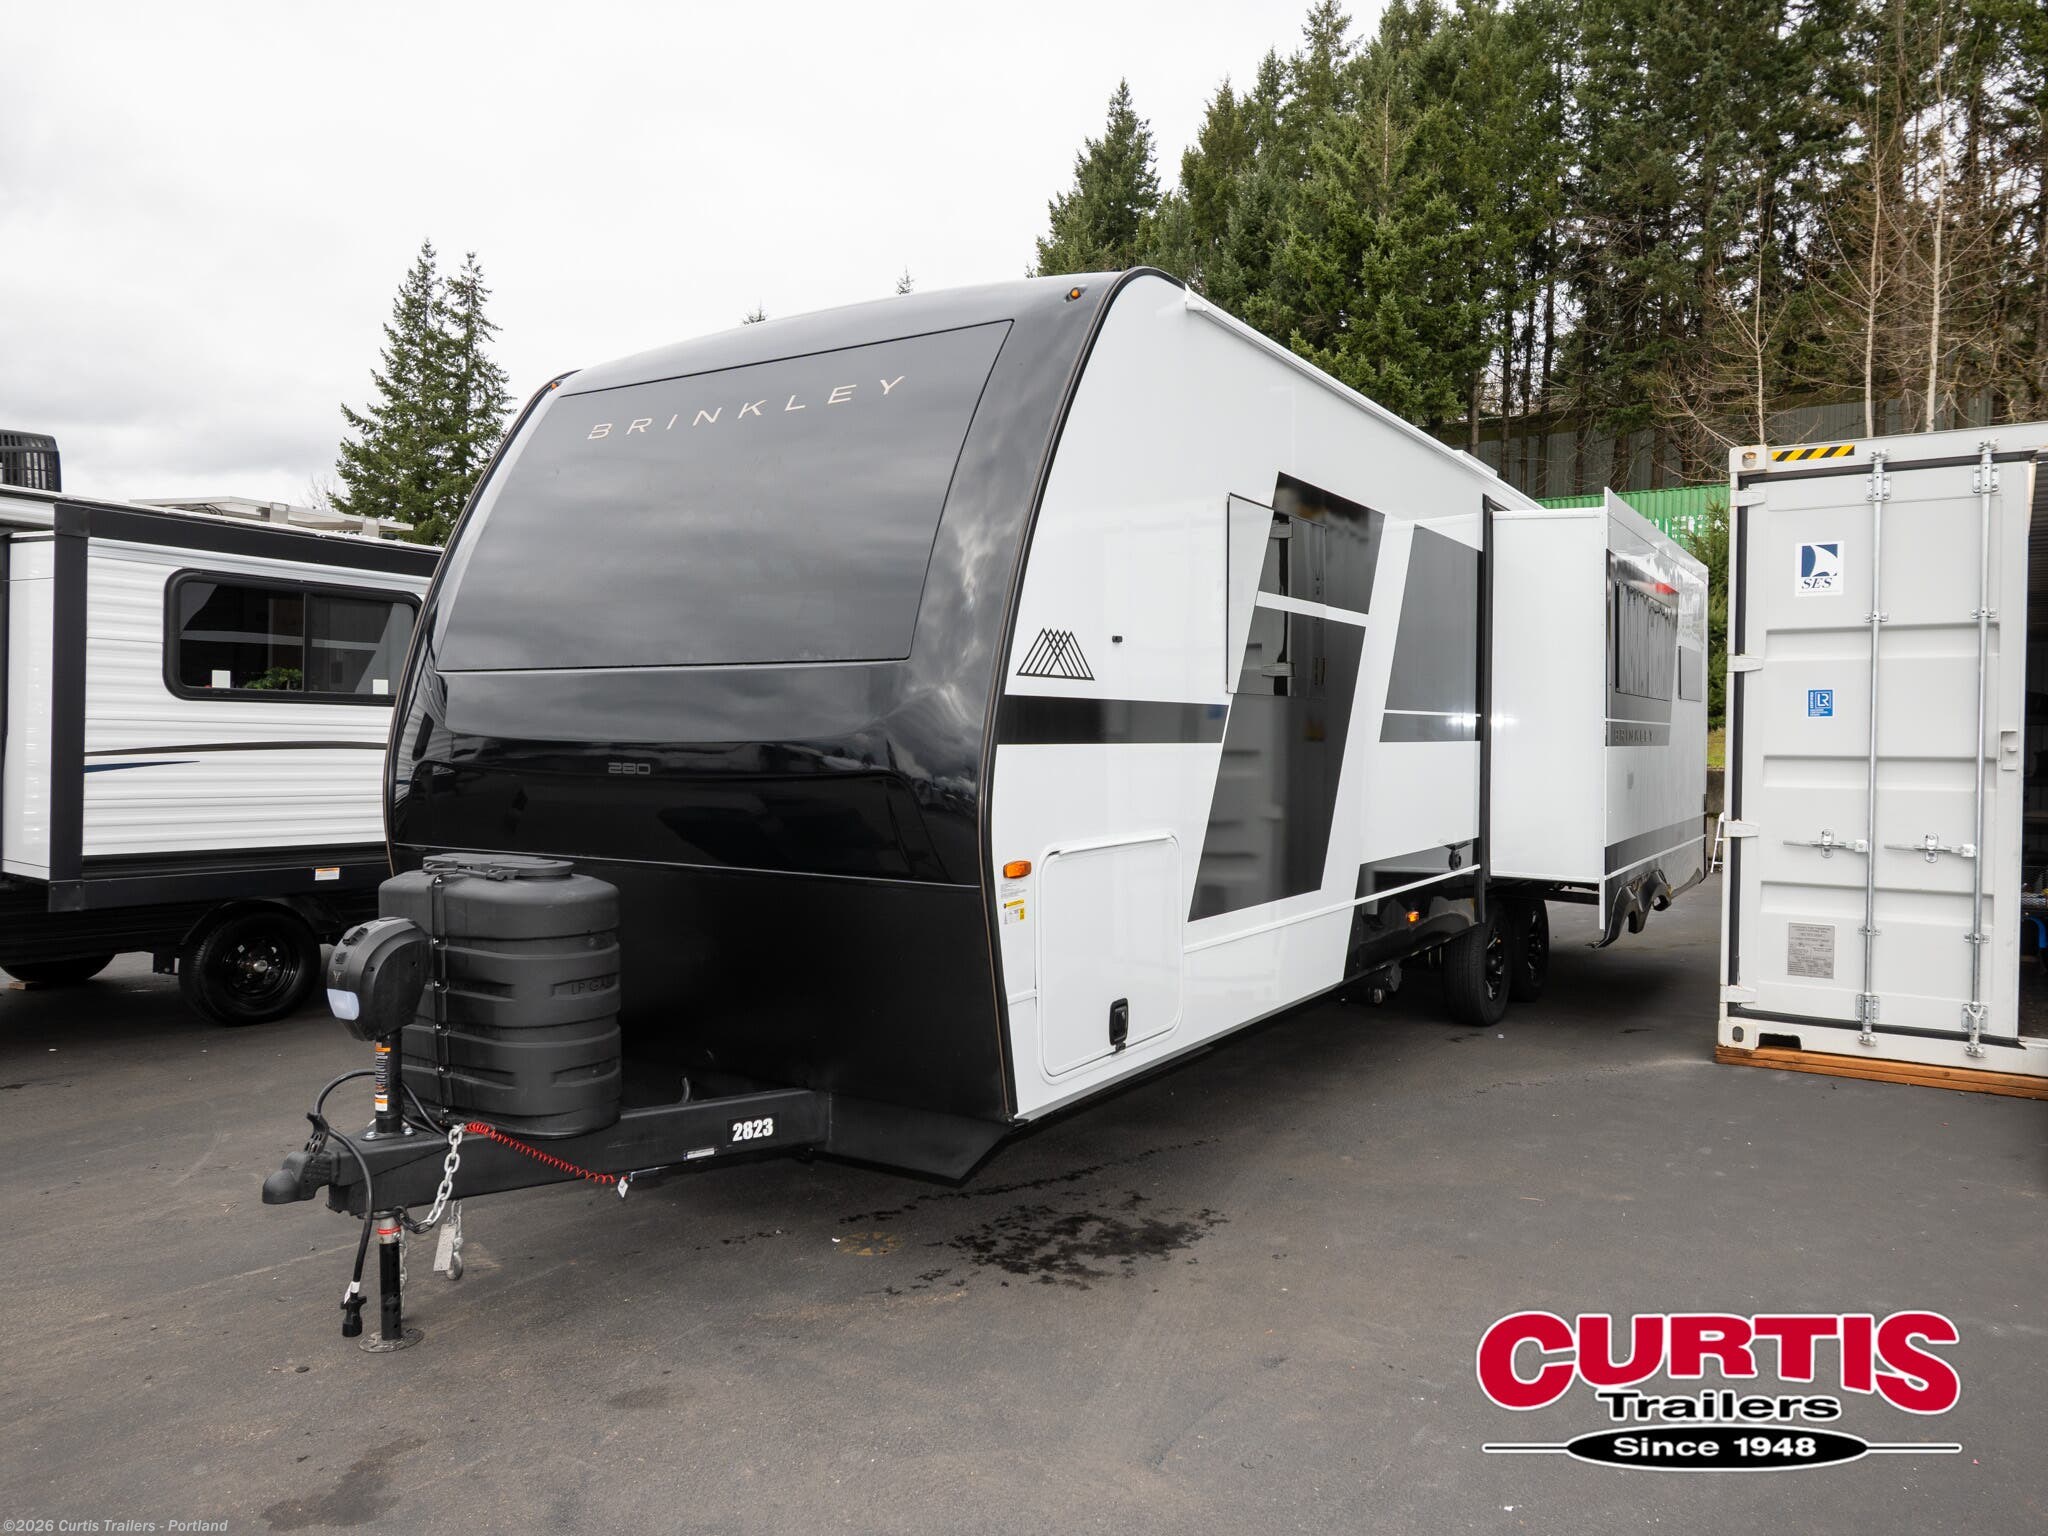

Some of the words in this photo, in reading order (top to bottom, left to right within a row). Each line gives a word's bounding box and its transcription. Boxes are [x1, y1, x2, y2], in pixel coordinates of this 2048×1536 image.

[587, 375, 905, 440] BRINKLEY
[1801, 577, 1833, 590] SES
[732, 1117, 774, 1142] 2823
